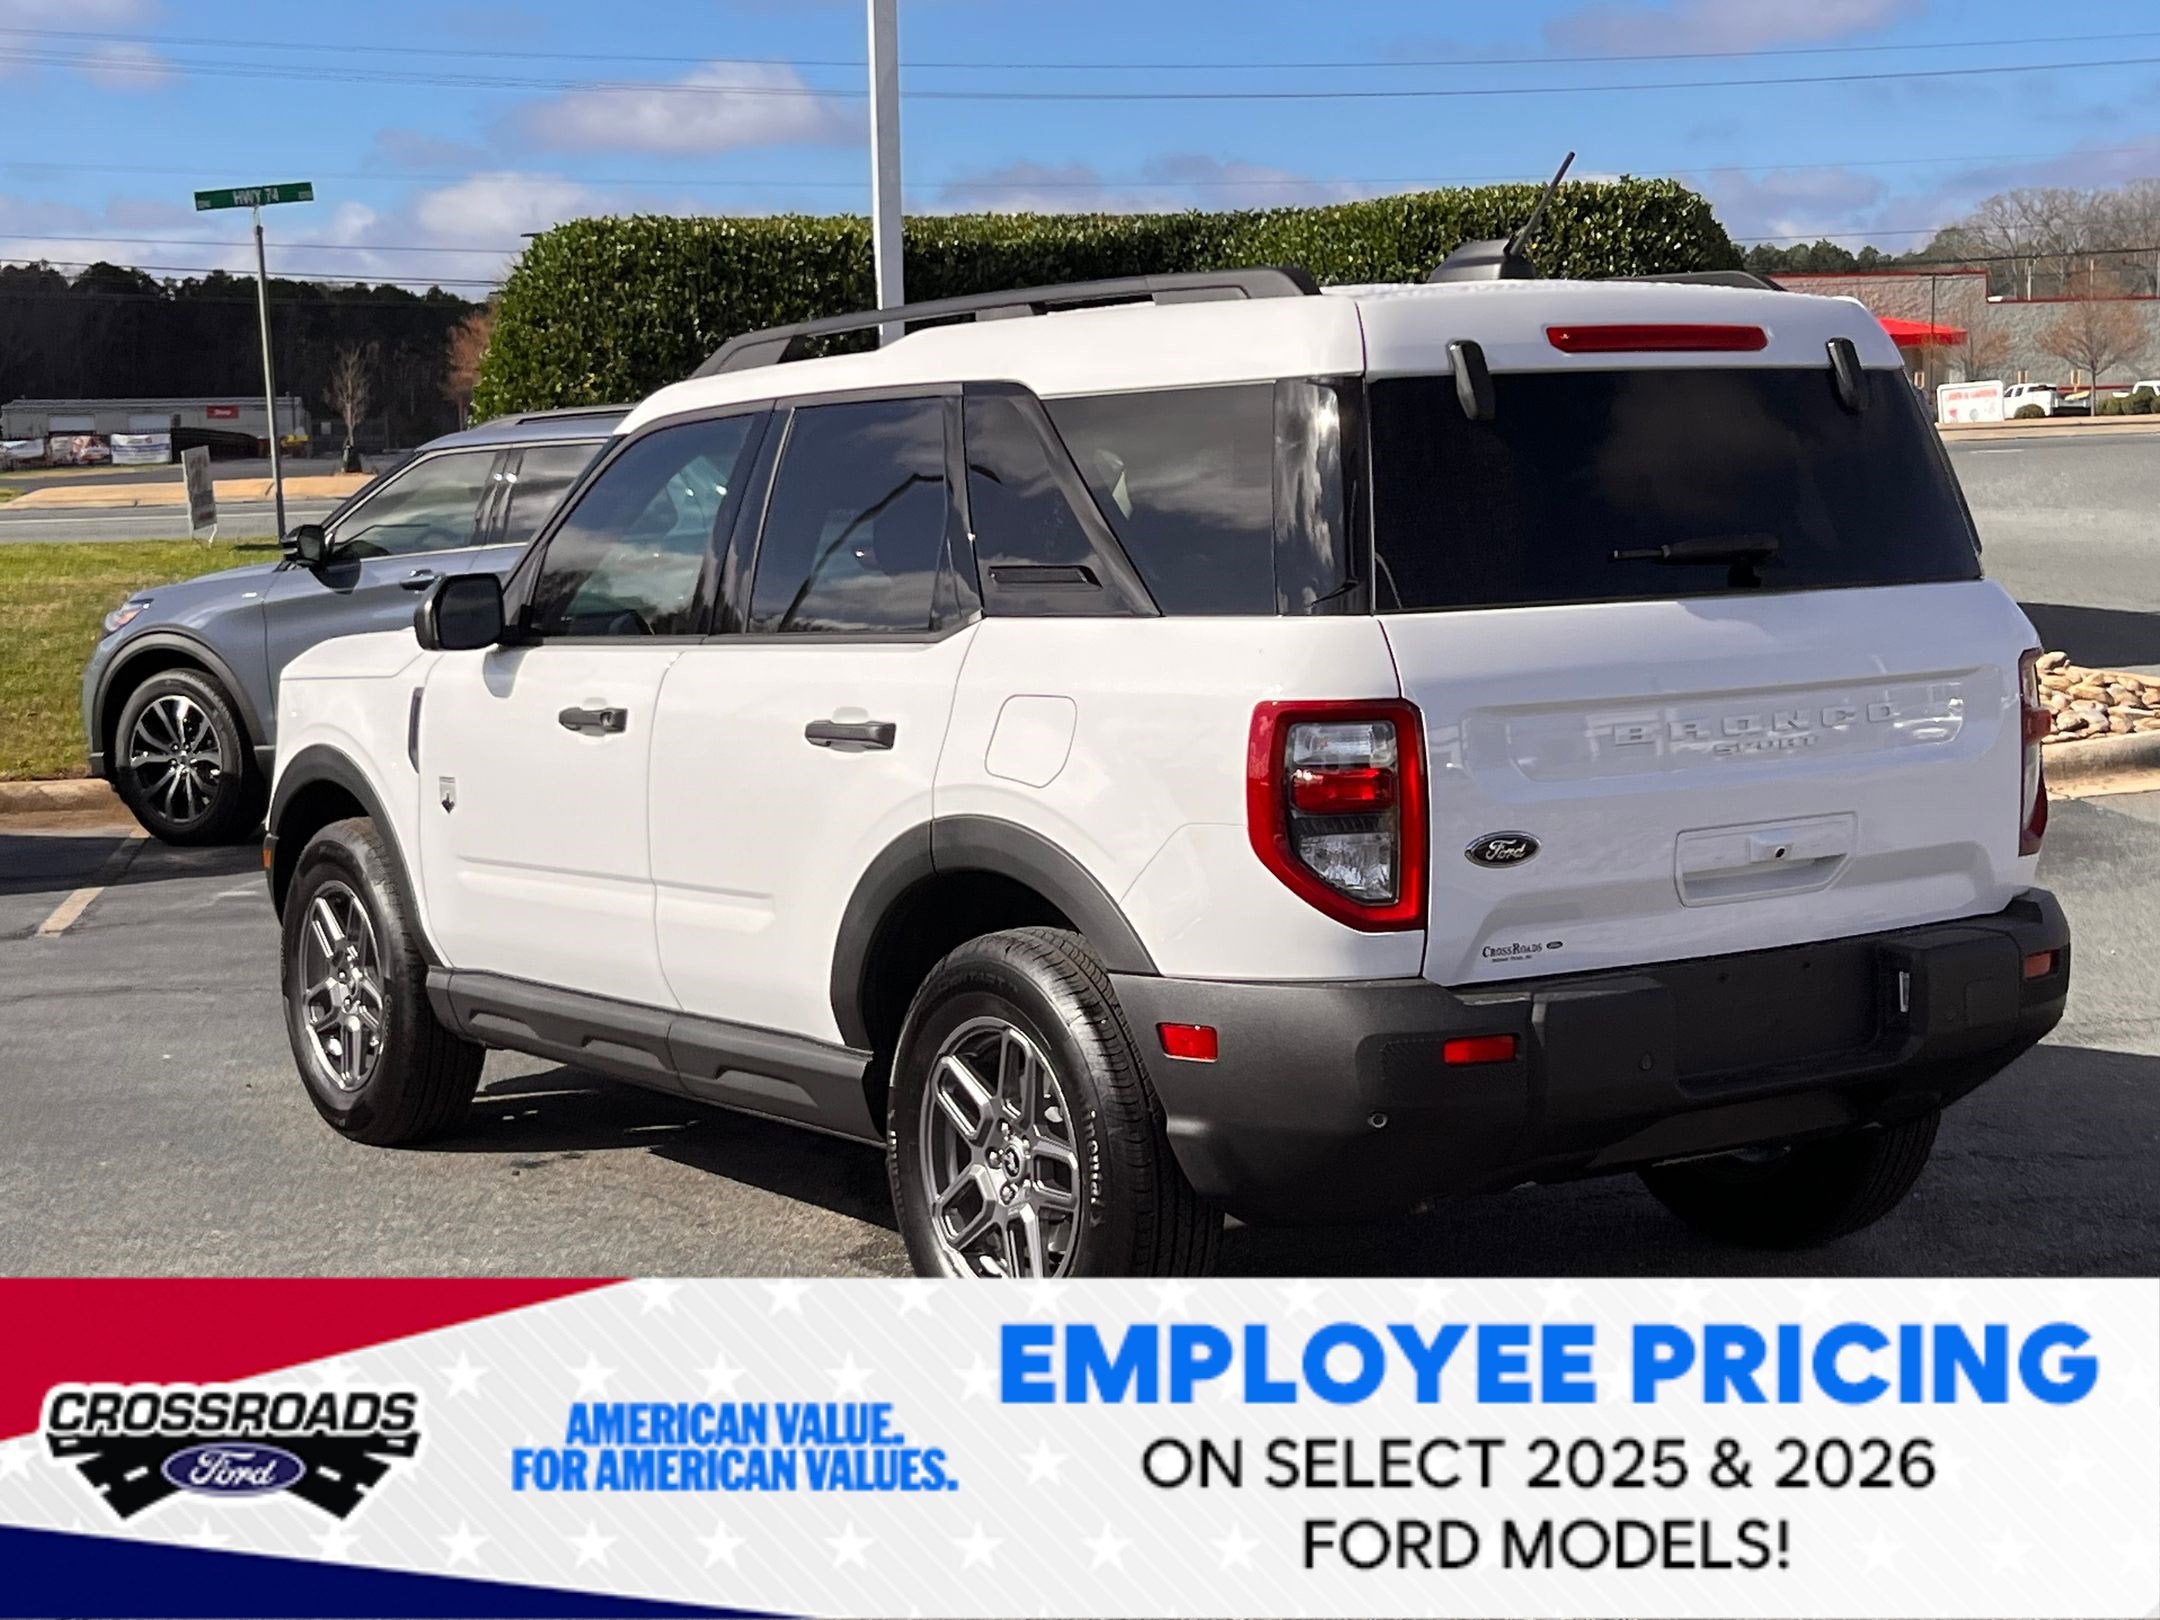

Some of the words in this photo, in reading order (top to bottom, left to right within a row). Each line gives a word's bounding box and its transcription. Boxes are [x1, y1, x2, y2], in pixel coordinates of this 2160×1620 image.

[233, 188, 261, 205] HWY
[263, 187, 280, 203] 74
[1612, 702, 1893, 747] BRONCO
[1713, 735, 1818, 757] SPORT
